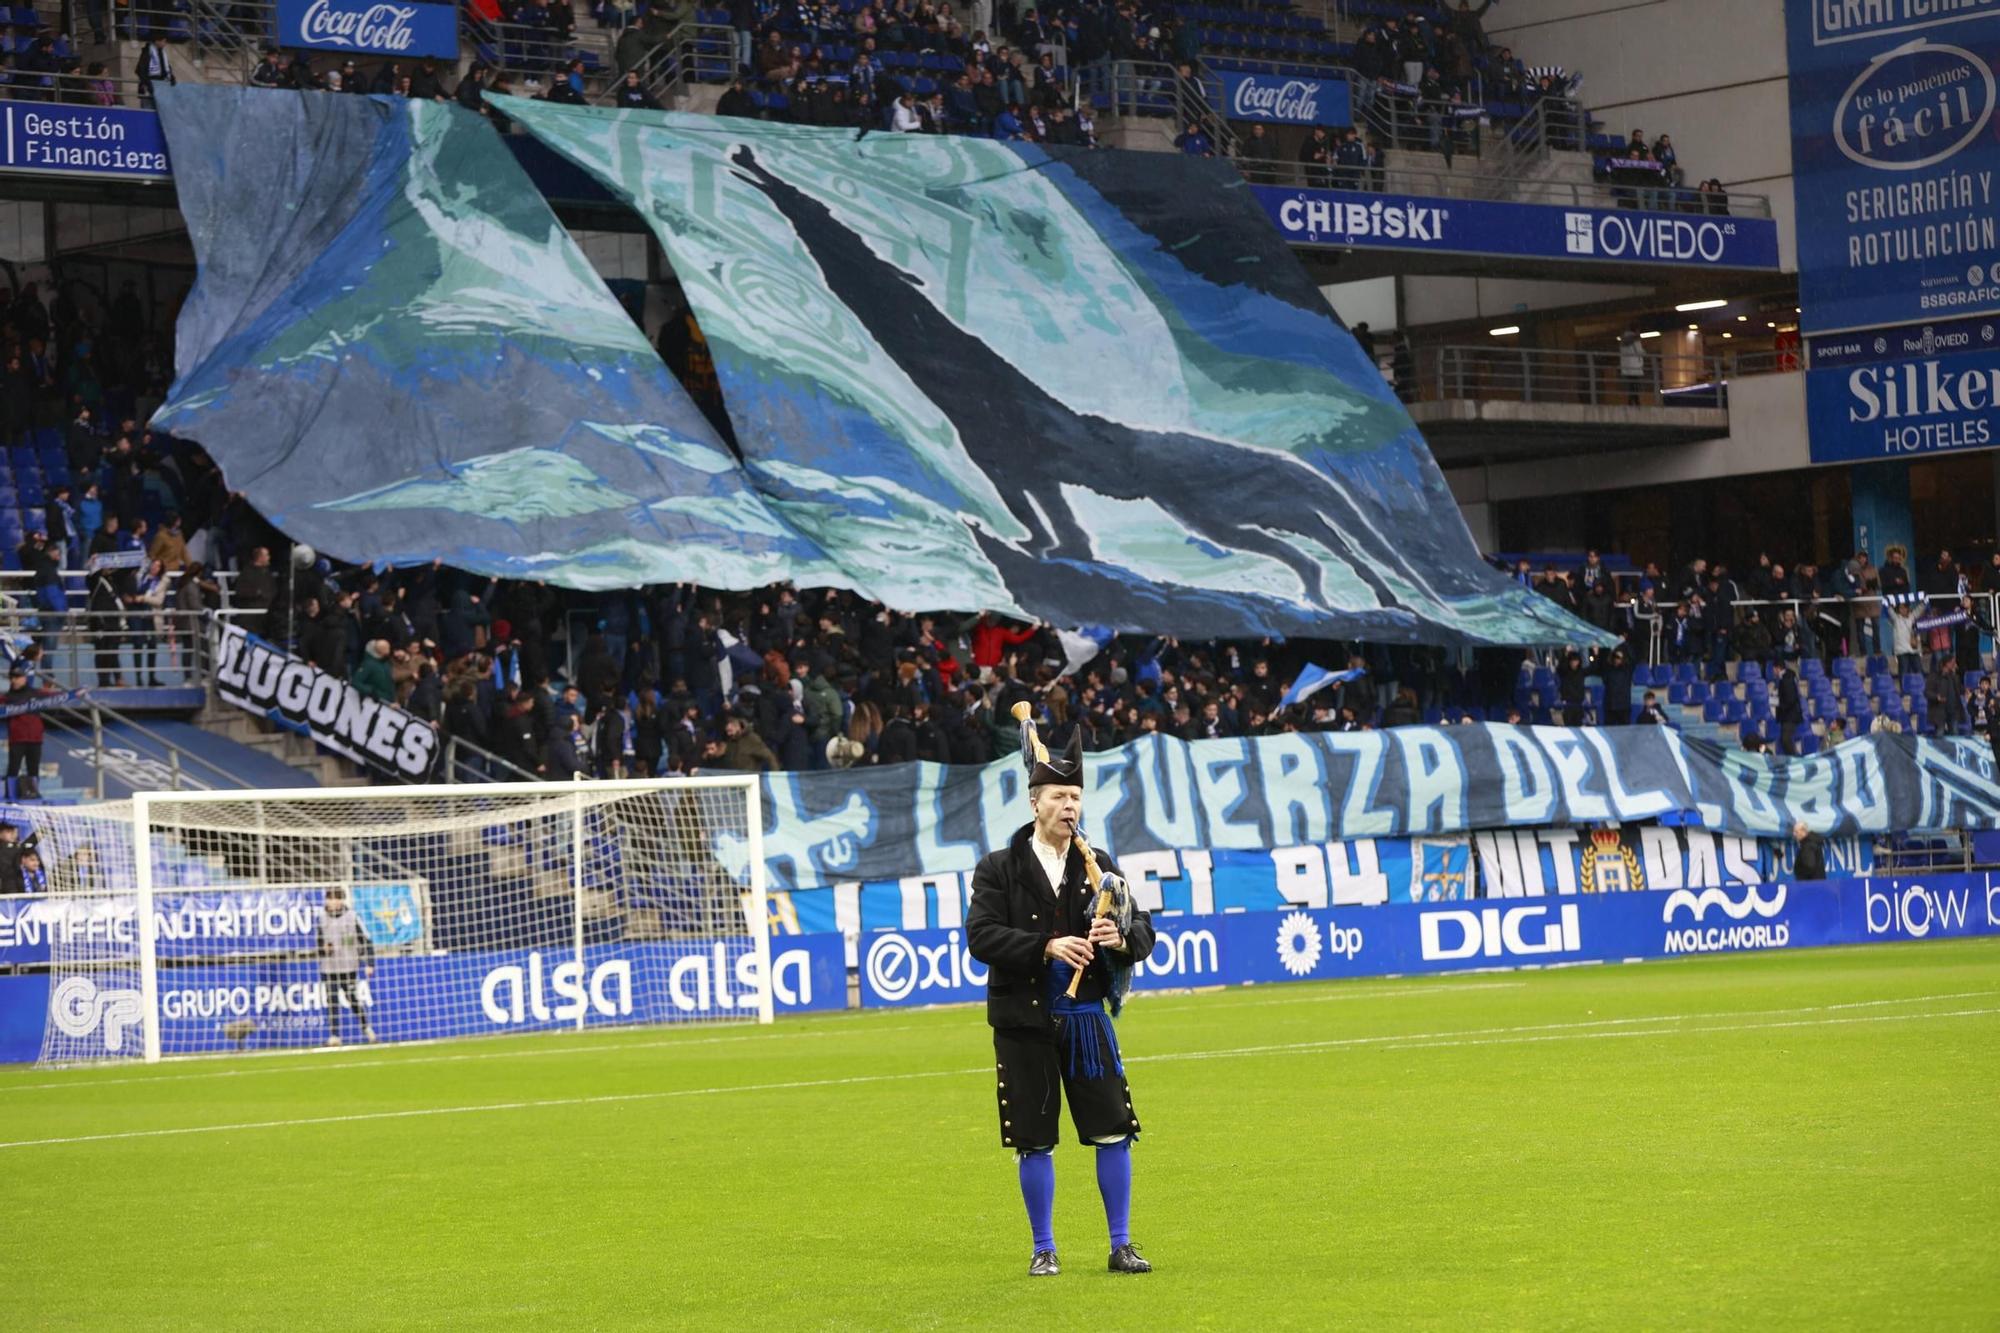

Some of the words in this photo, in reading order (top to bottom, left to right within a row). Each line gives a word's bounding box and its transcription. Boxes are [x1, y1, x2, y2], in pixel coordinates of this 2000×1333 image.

[1856, 95, 1873, 111] te
[1877, 88, 1893, 104] lo
[1898, 64, 1971, 103] ponemos
[25, 113, 125, 141] Gestión
[1857, 86, 1973, 154] fácil
[26, 141, 167, 170] Financiera
[1846, 170, 1973, 223] SERIGRAFÍA
[1979, 171, 1991, 204] Y
[1849, 213, 1995, 268] ROTULACIÓN
[1817, 345, 1843, 357] SPORT
[1845, 343, 1862, 354] BAR
[1904, 337, 1923, 351] Real
[1935, 333, 1969, 348] OVIEDO
[1885, 419, 1990, 453] HOTELES
[218, 634, 435, 775] LUGONES
[1484, 722, 1673, 823] DEL
[155, 906, 312, 939] NUTRITION
[1330, 921, 1363, 960] bp
[1419, 904, 1581, 961] DIGI
[481, 951, 632, 1024] alsa
[669, 941, 812, 1013] alsa
[163, 986, 249, 1018] GRUPO
